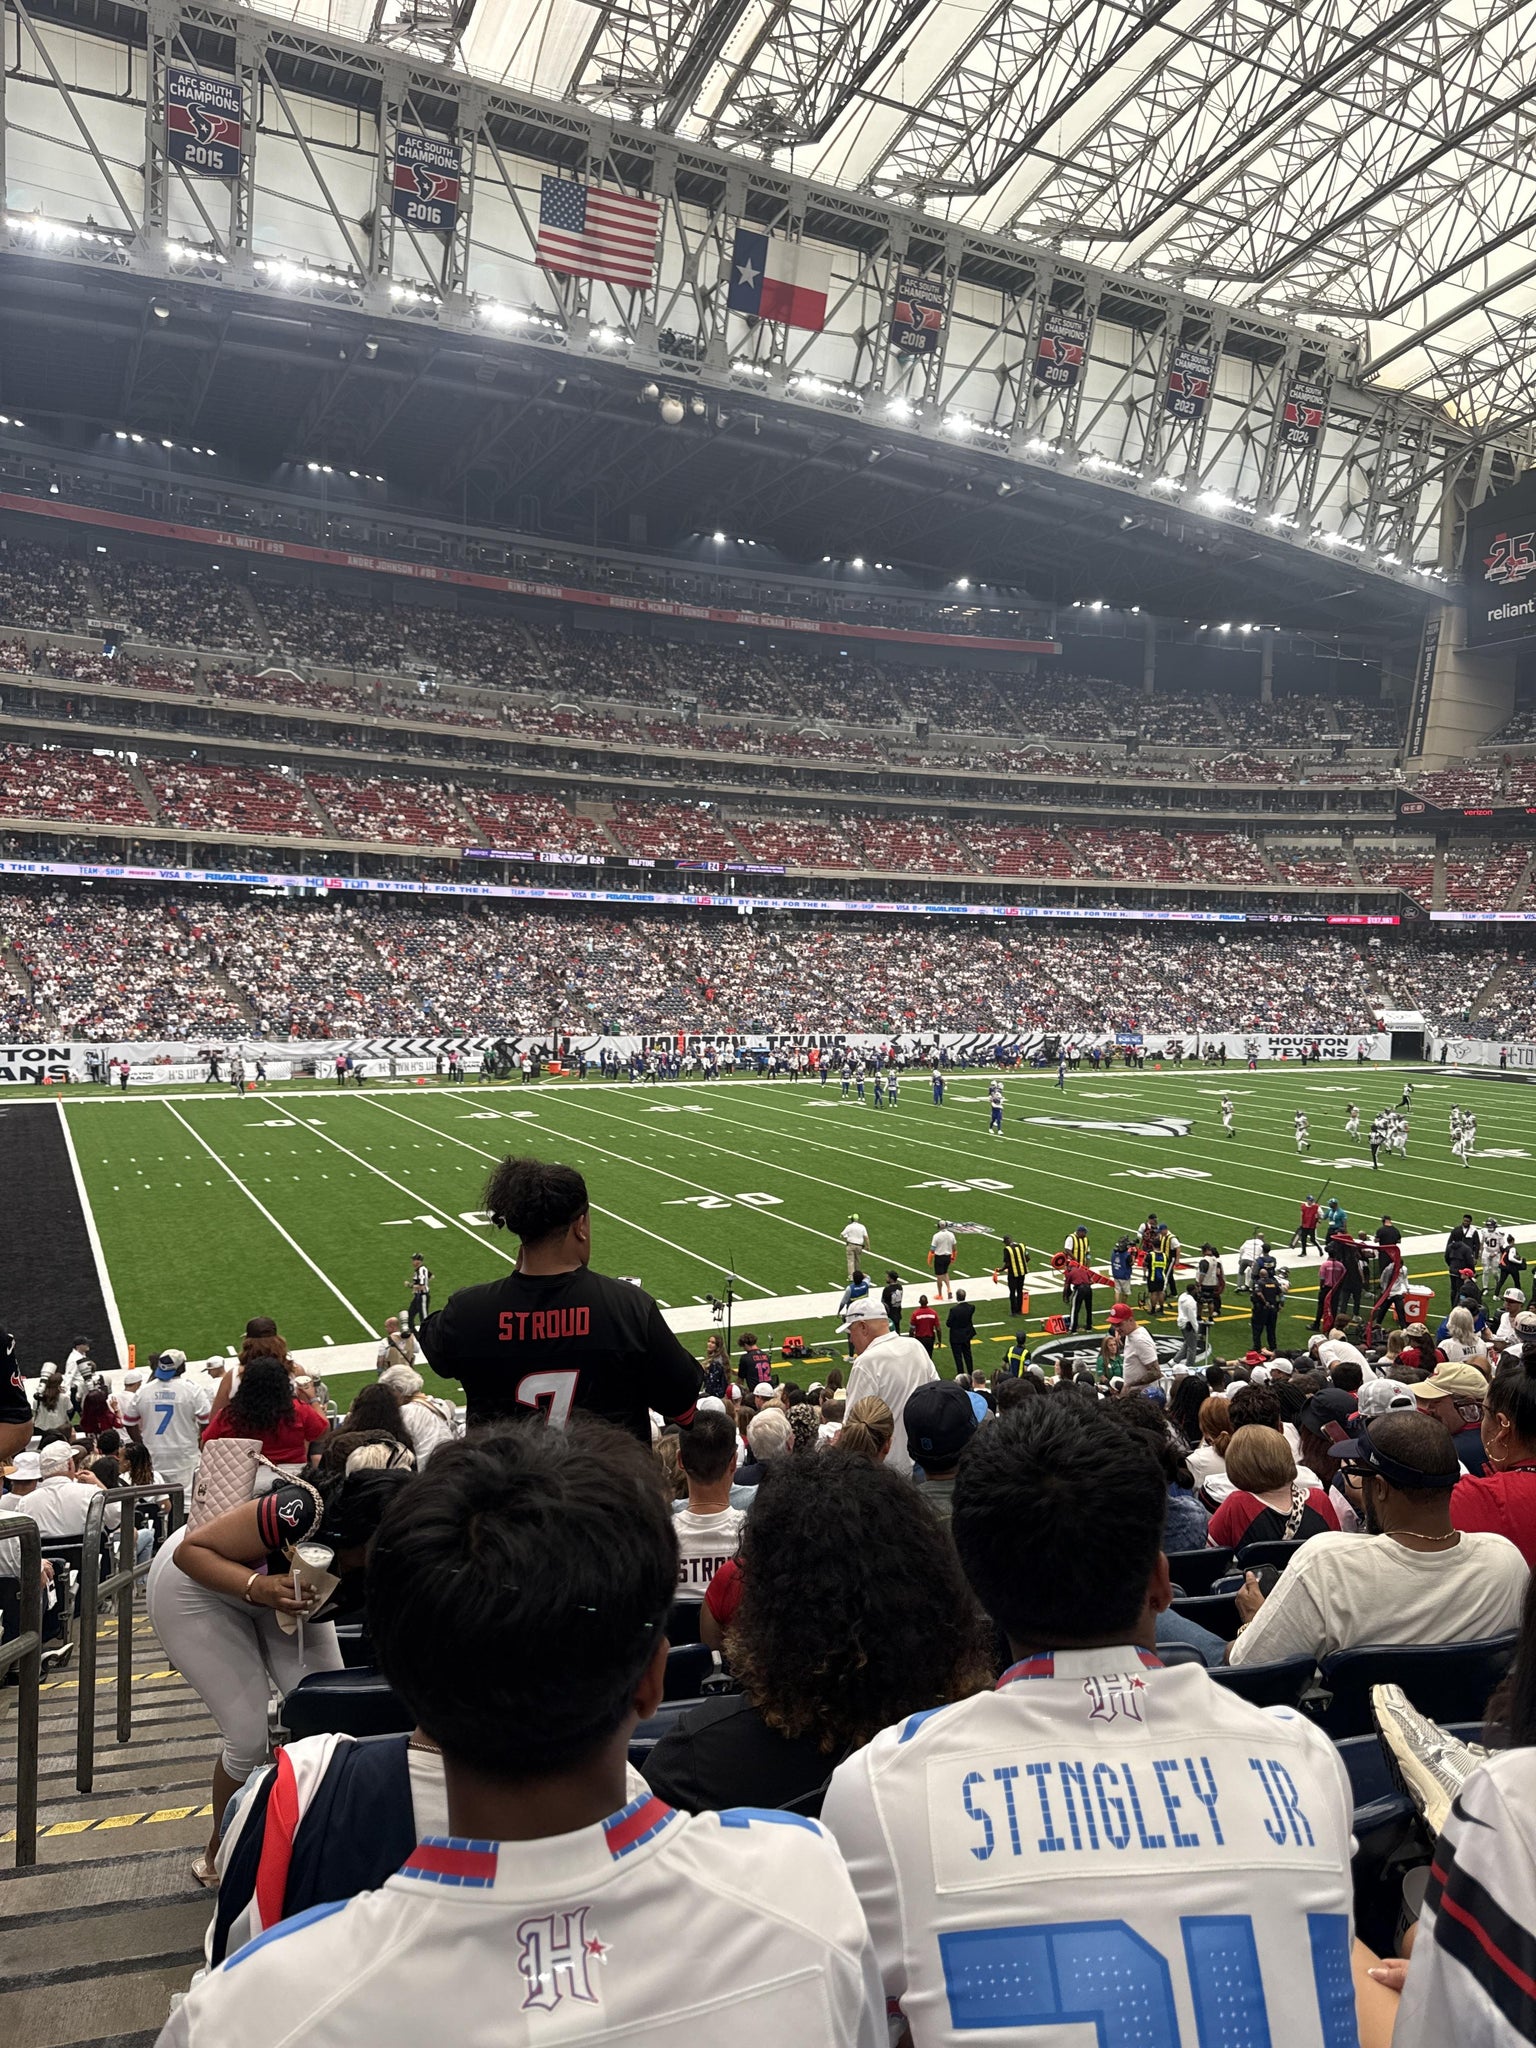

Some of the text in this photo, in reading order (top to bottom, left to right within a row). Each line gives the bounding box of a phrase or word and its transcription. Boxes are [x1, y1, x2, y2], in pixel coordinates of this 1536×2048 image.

[178, 75, 232, 98] AFC SOUTH
[170, 83, 239, 112] CHAMPIONS
[405, 137, 453, 157] AFC SOUTH
[185, 144, 223, 169] 2015
[398, 145, 459, 170] CHAMPIONS
[407, 202, 441, 224] 2016
[905, 278, 940, 294] AFC SOUTH
[900, 285, 943, 304] CHAMPIONS
[1044, 323, 1085, 340] CHAMPIONS
[1050, 316, 1082, 331] AFC SOUTH
[901, 331, 926, 349] 2018
[1045, 366, 1069, 382] 2019
[1175, 358, 1210, 374] CHAMPIONS
[1174, 398, 1196, 414] 2023
[1287, 428, 1309, 443] 2024
[236, 538, 258, 549] WATT
[348, 555, 375, 568] ANDRE
[376, 559, 413, 574] JOHNSON
[1490, 532, 1535, 581] 25
[1488, 600, 1535, 621] reliant
[1464, 808, 1493, 816] verizon
[10, 863, 35, 872] THE
[628, 858, 655, 868] HALFTIME
[160, 870, 180, 878] VISA
[205, 873, 269, 883] RIVALRIES
[306, 878, 369, 889] HOUSTON
[393, 883, 414, 891] THE
[435, 885, 455, 893] FOR
[459, 886, 478, 894] THE
[683, 896, 732, 905] HOUSTON
[993, 907, 1038, 916] HOUSTON
[1268, 1038, 1348, 1046] HOUSTON
[1127, 1167, 1213, 1179] 40
[923, 1178, 1014, 1192] 30
[684, 1192, 784, 1209] 20
[1404, 1300, 1421, 1317] G
[498, 1306, 590, 1340] STROUD
[1051, 1318, 1066, 1334] 20
[1462, 1346, 1477, 1356] WATT
[755, 1362, 772, 1382] 12
[155, 1391, 176, 1400] STROUD
[155, 1404, 174, 1435] 7
[961, 1757, 1316, 1861] STINGLEY JR
